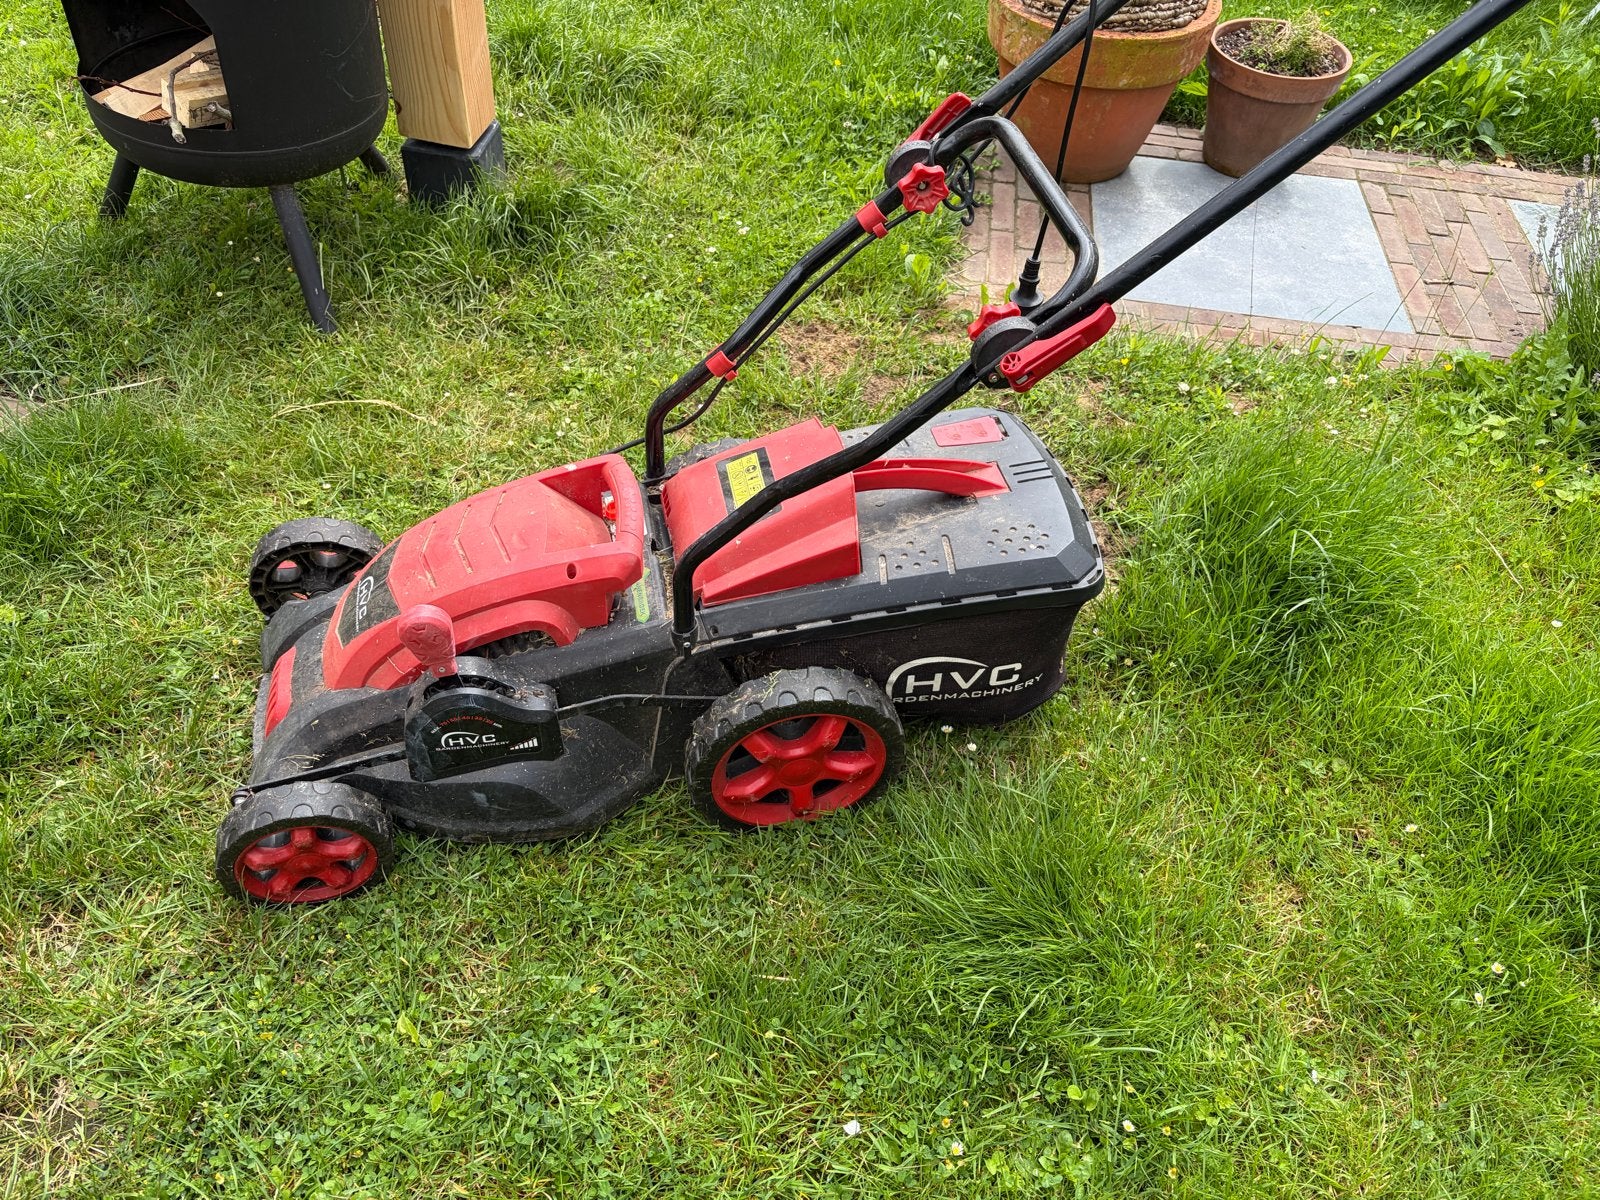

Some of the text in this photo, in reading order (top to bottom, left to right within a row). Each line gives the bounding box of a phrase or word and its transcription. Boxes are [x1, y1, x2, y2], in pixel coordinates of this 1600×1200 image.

[892, 672, 1044, 704] RDENMACHINERY
[904, 661, 1023, 695] HVC
[447, 733, 497, 747] HVC
